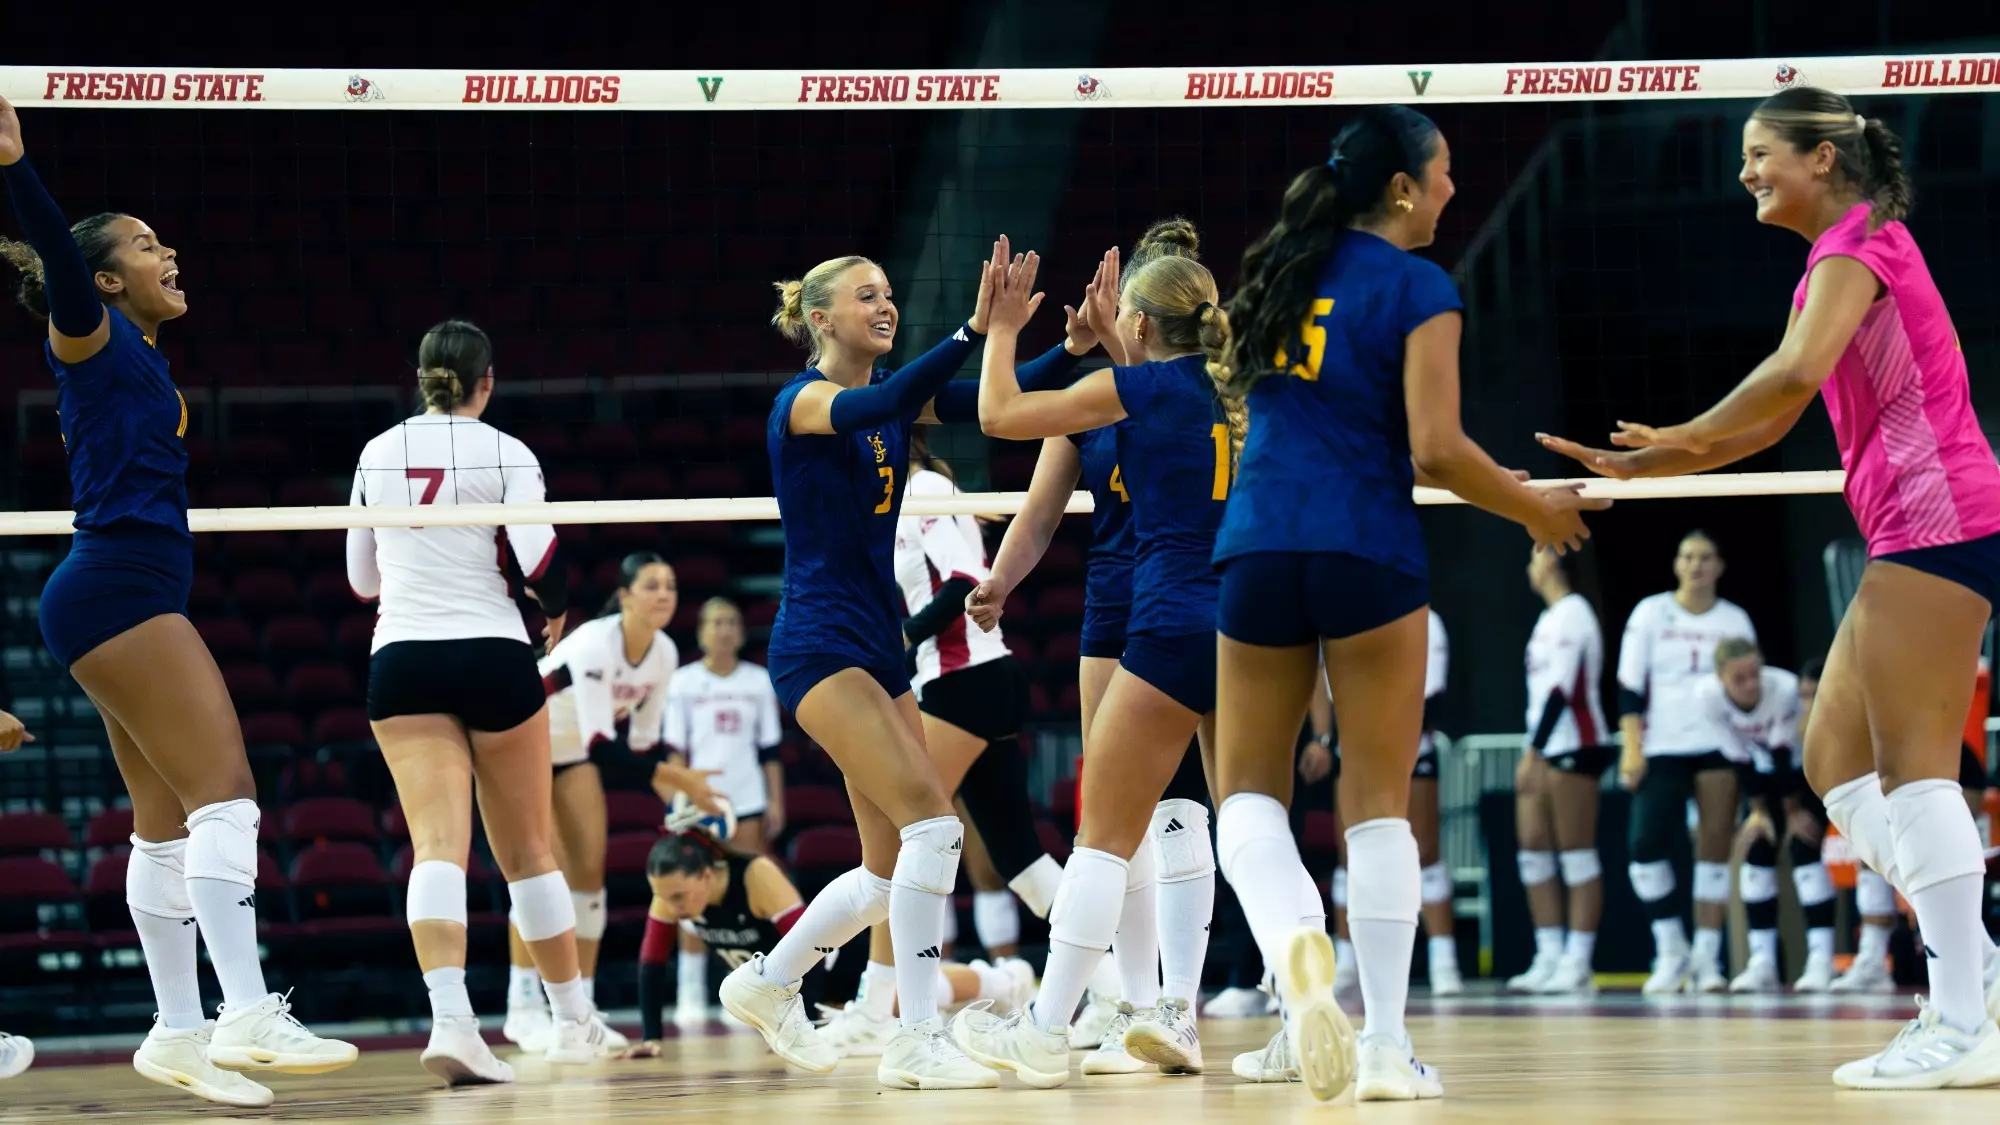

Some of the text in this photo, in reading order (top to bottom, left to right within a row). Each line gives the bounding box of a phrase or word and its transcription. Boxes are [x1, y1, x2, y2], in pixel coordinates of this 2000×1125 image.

[43, 73, 263, 101] FRESNO STATE
[462, 75, 620, 103] BULLDOGS
[698, 77, 723, 101] V
[798, 75, 999, 102] FRESNO STATE
[1185, 72, 1334, 99] BULLDOGS
[1408, 71, 1432, 96] V
[1504, 65, 1700, 94] FRESNO STATE
[1210, 423, 1230, 500] 1
[874, 466, 893, 514] 3
[1109, 463, 1130, 502] 4
[405, 468, 445, 529] 7
